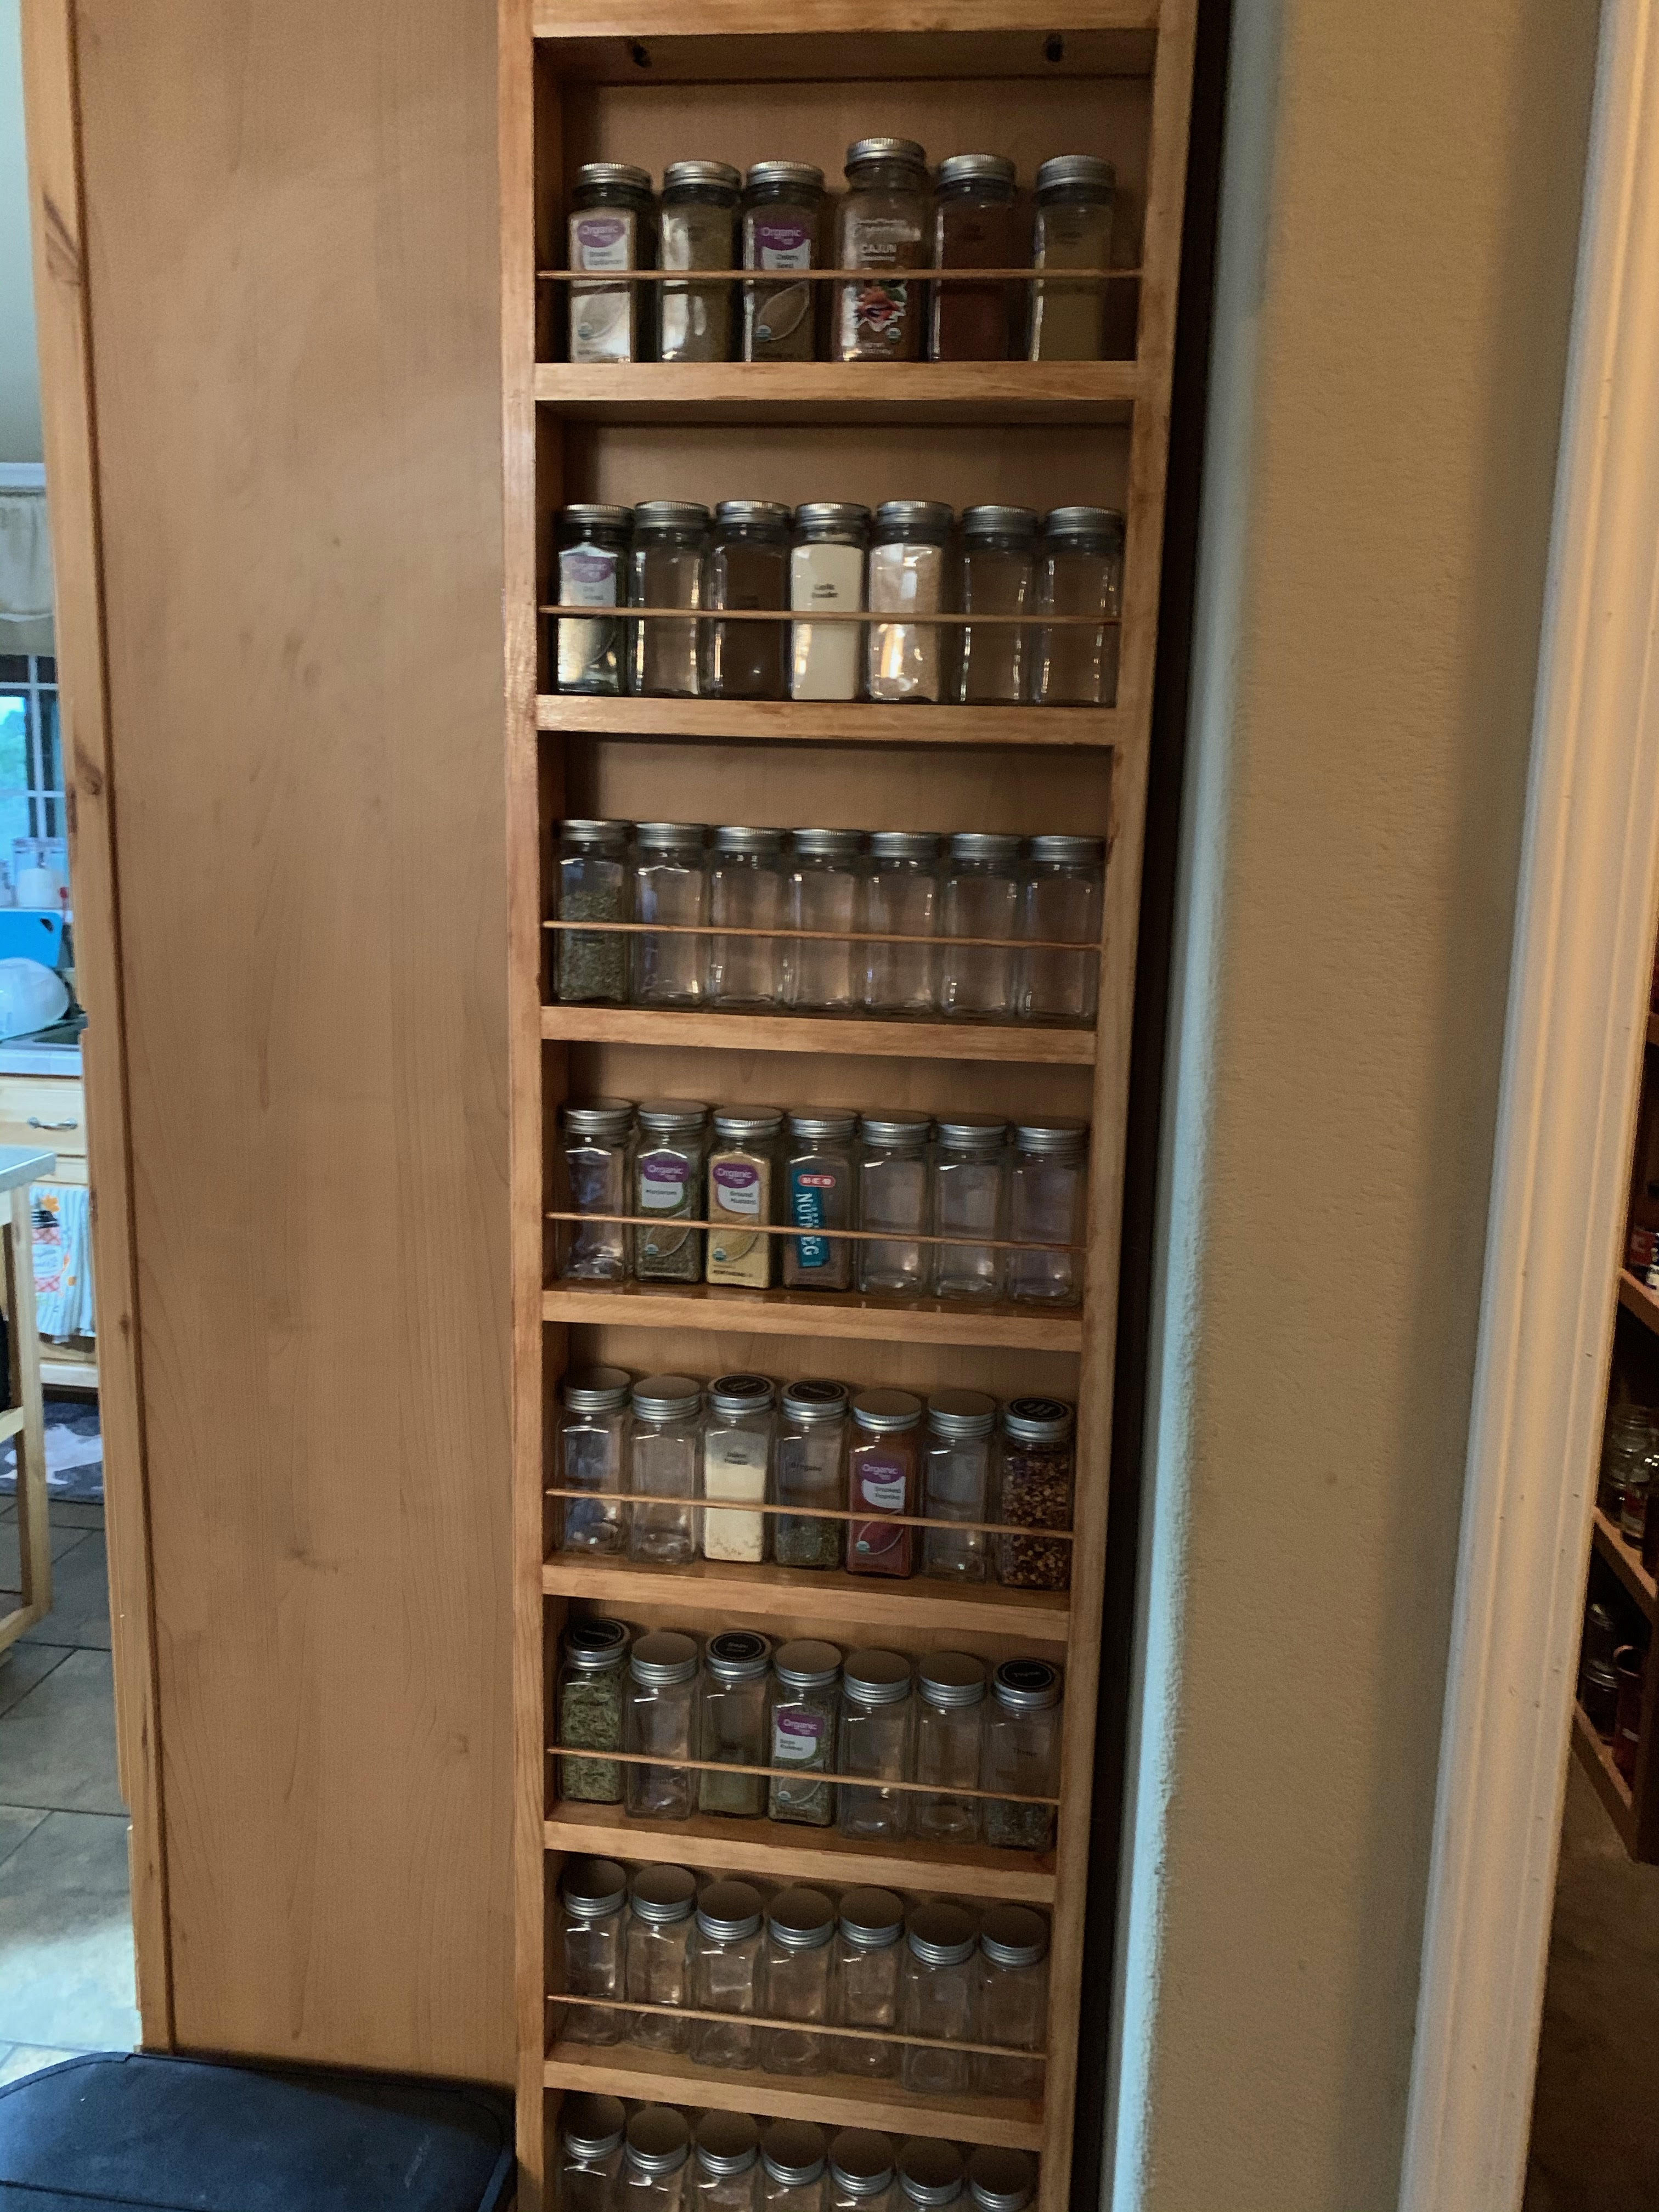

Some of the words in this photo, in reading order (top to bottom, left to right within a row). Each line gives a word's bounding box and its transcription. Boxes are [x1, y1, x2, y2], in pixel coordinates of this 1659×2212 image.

[761, 227, 802, 240] Organic
[647, 1164, 684, 1176] Organic
[716, 1168, 752, 1180] Organic
[791, 1462, 823, 1472] Oregano
[863, 1464, 899, 1476] Organic
[783, 1719, 817, 1730] Organic
